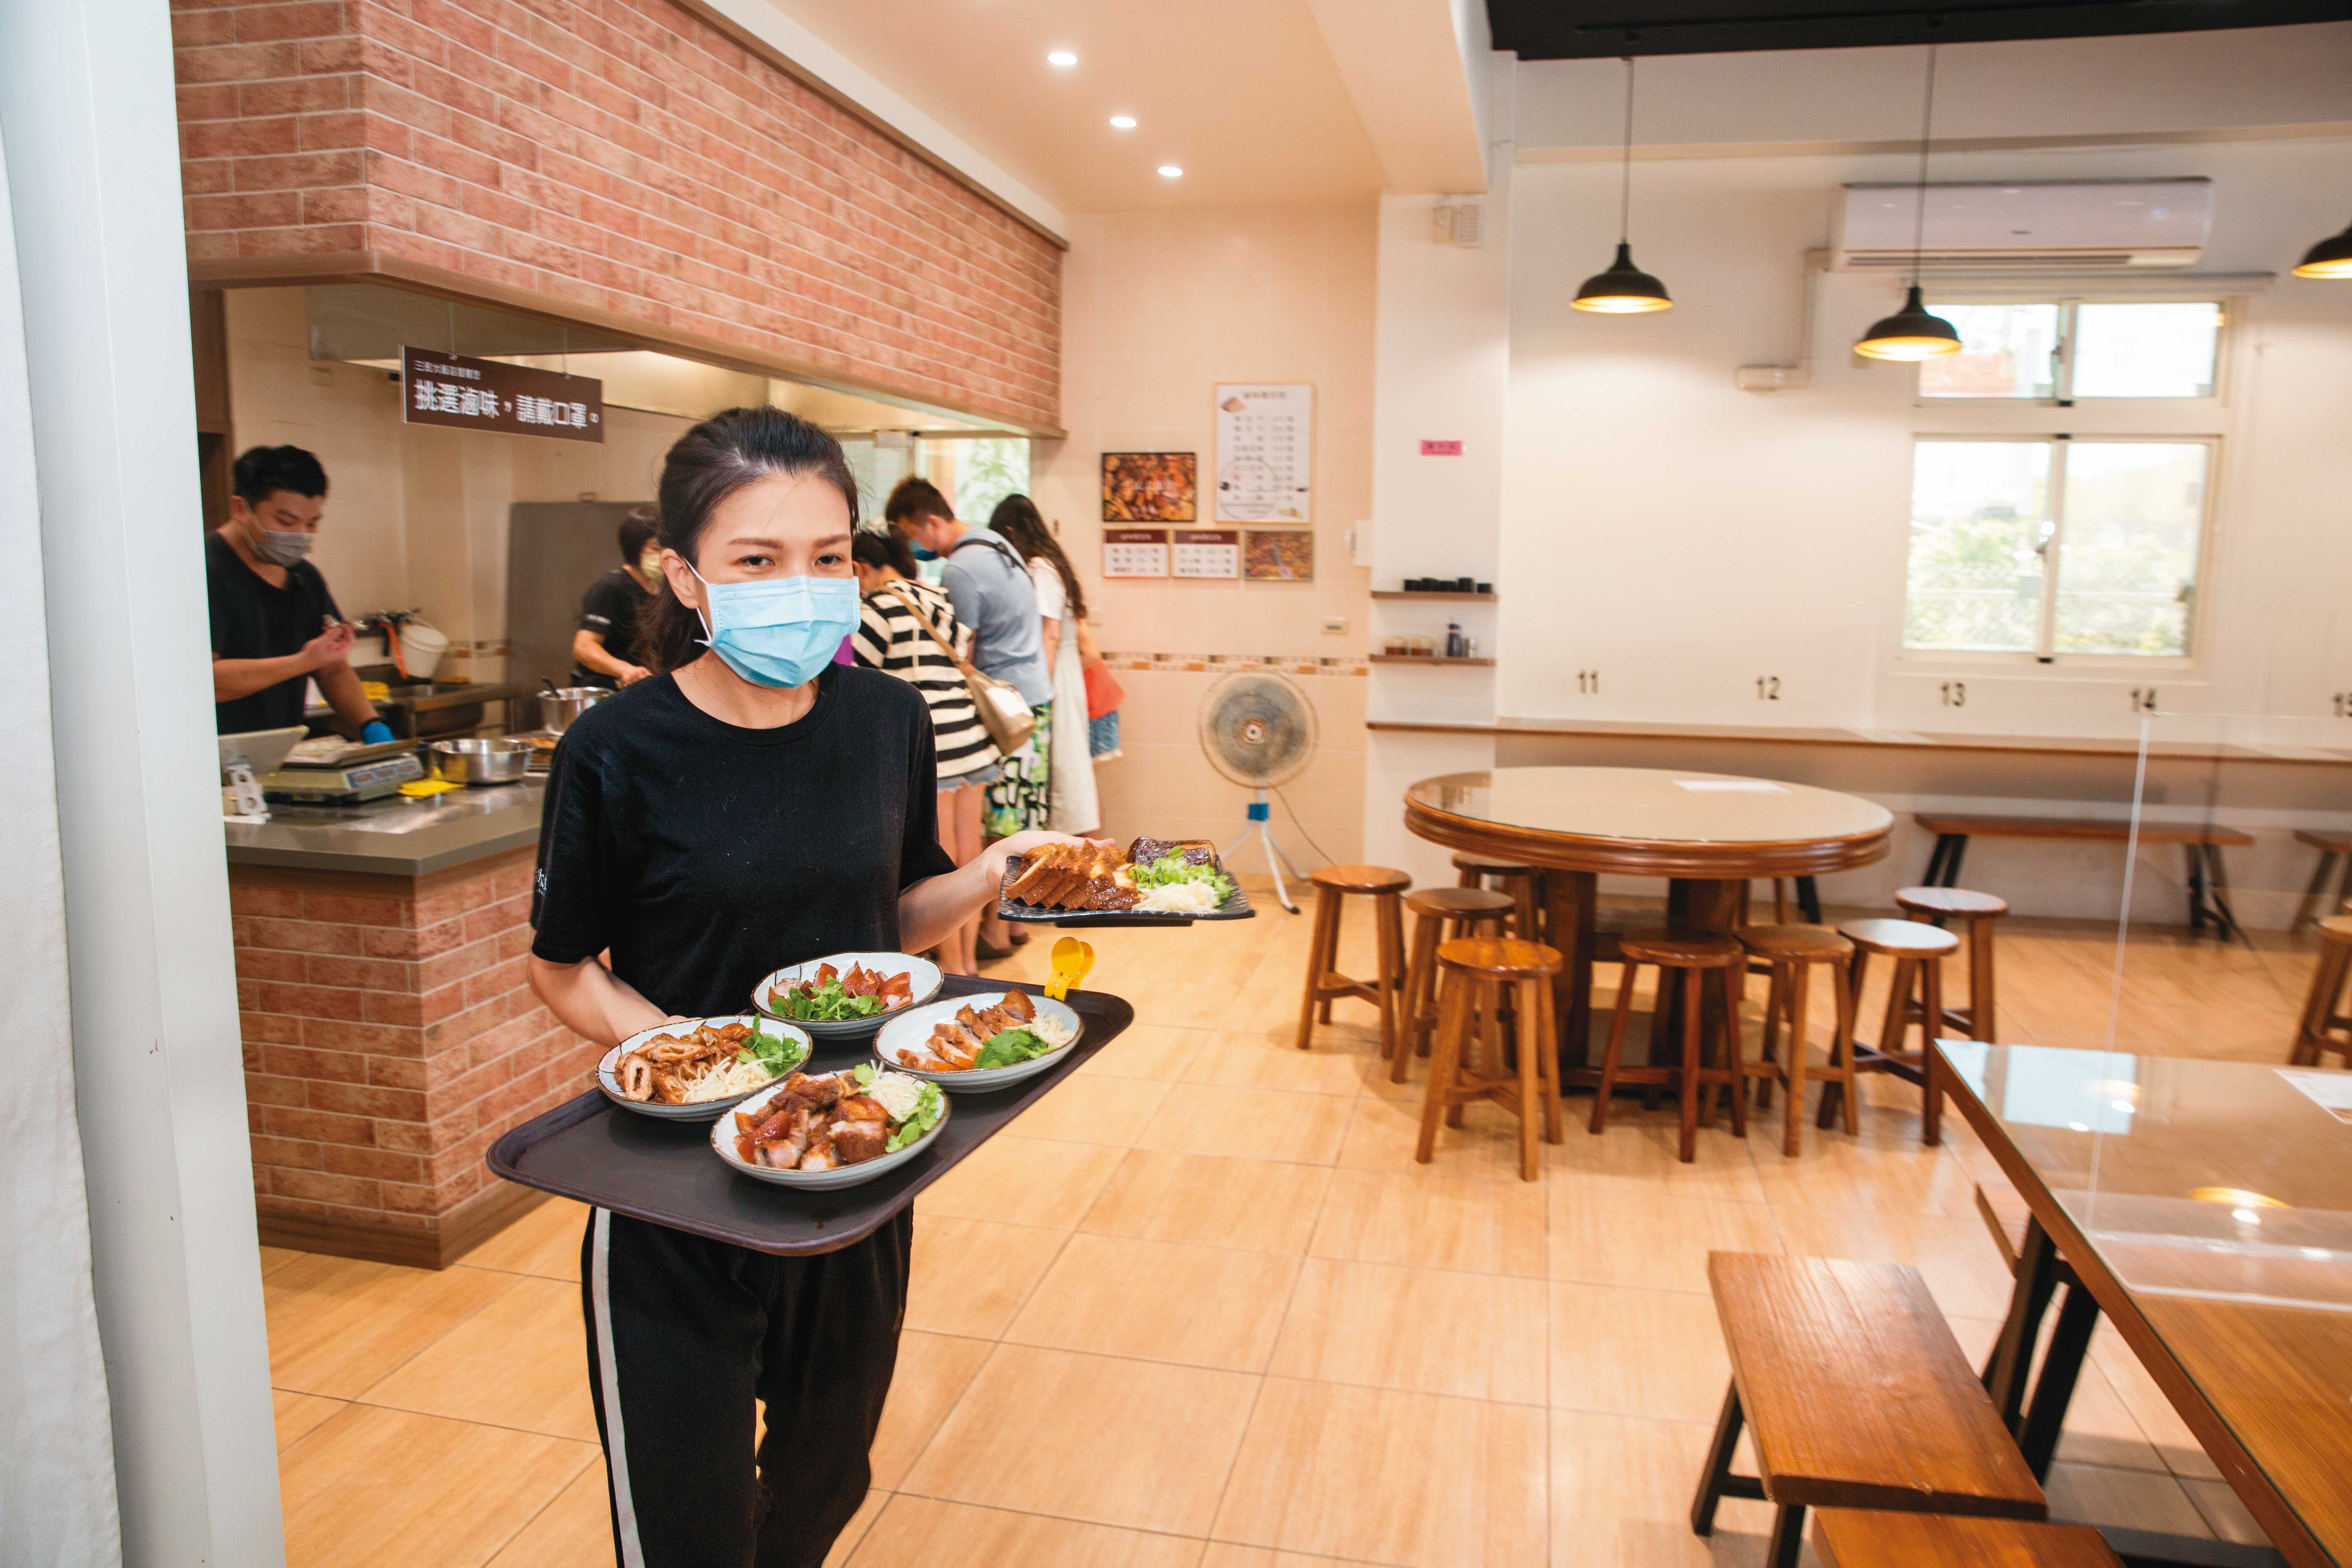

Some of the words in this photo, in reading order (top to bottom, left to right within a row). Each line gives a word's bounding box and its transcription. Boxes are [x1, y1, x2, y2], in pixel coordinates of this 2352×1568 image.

[1579, 670, 1598, 694] 11
[1756, 676, 1780, 700] 12
[1941, 682, 1965, 707] 13
[2131, 688, 2156, 713] 14
